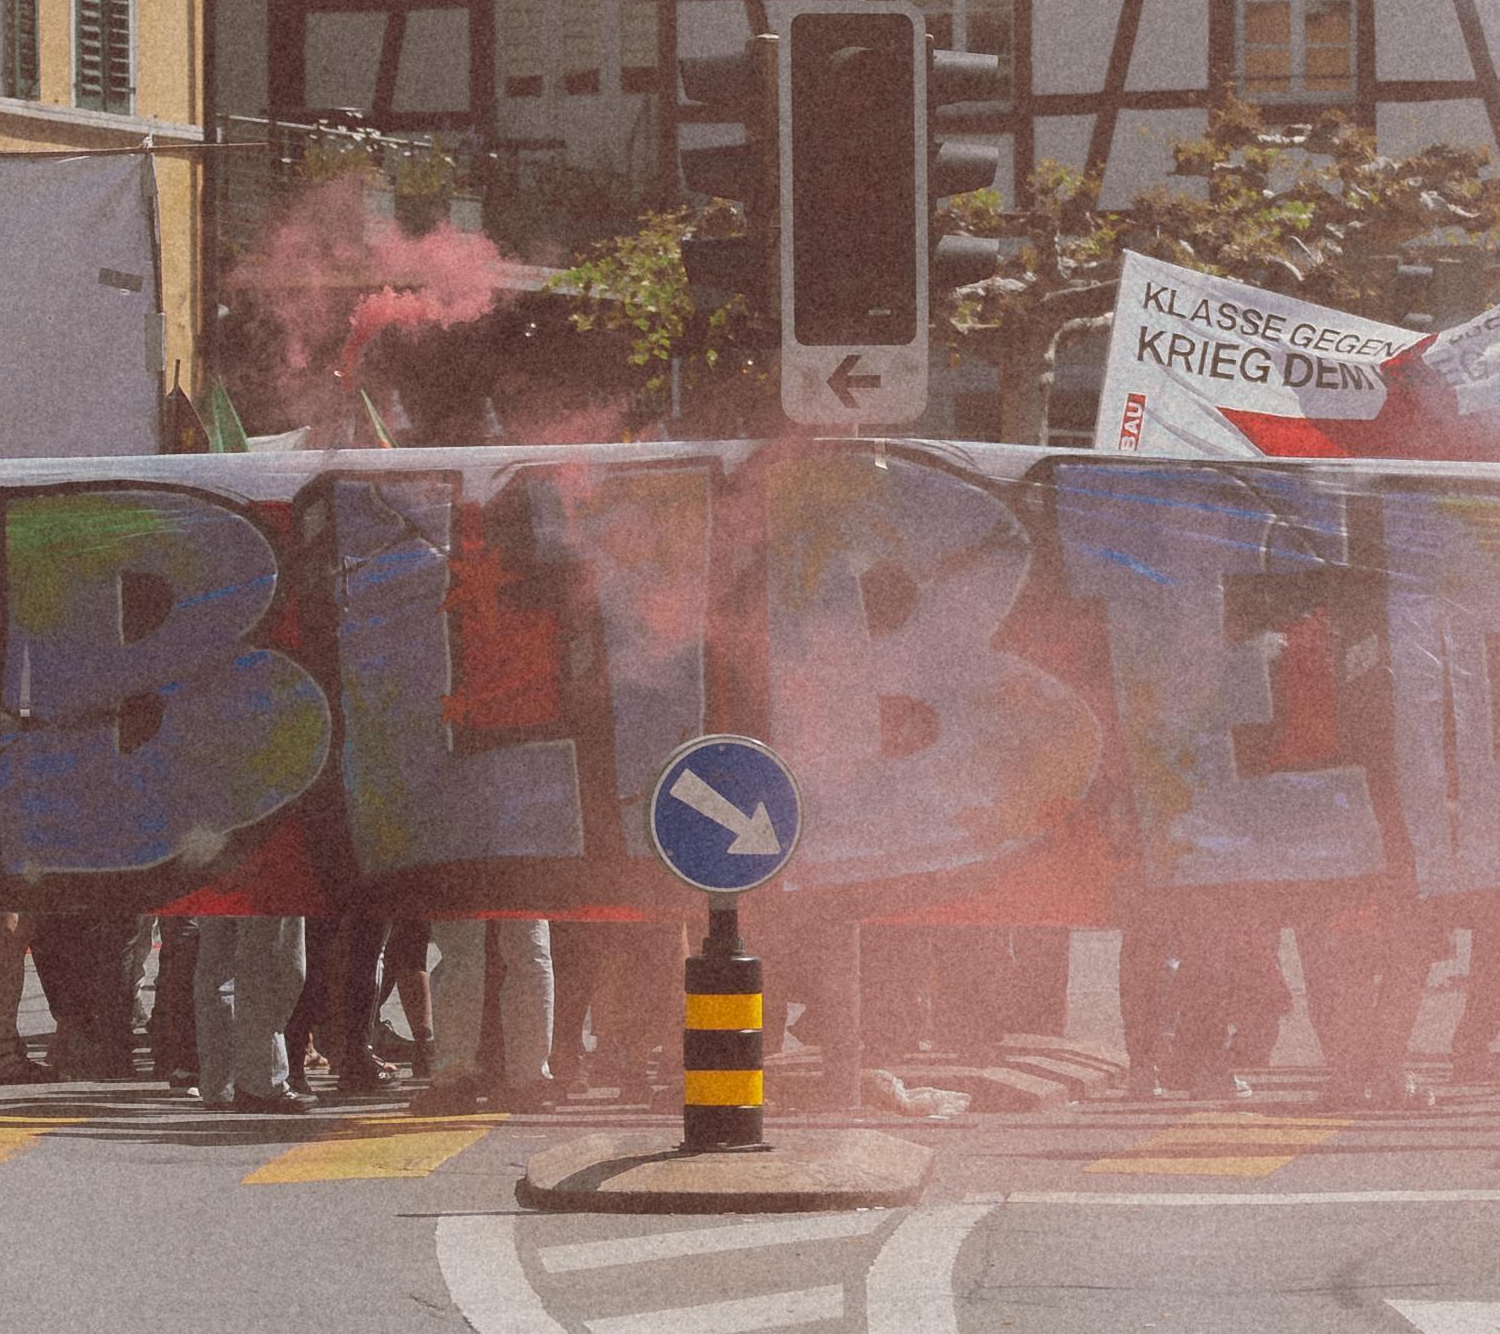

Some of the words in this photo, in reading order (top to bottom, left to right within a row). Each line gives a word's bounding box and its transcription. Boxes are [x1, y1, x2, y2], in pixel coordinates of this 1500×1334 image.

[1143, 281, 1286, 342] KLASSE
[1289, 323, 1405, 358] GEGEN
[1136, 325, 1271, 384] KRIEG
[1283, 353, 1374, 390] DEM
